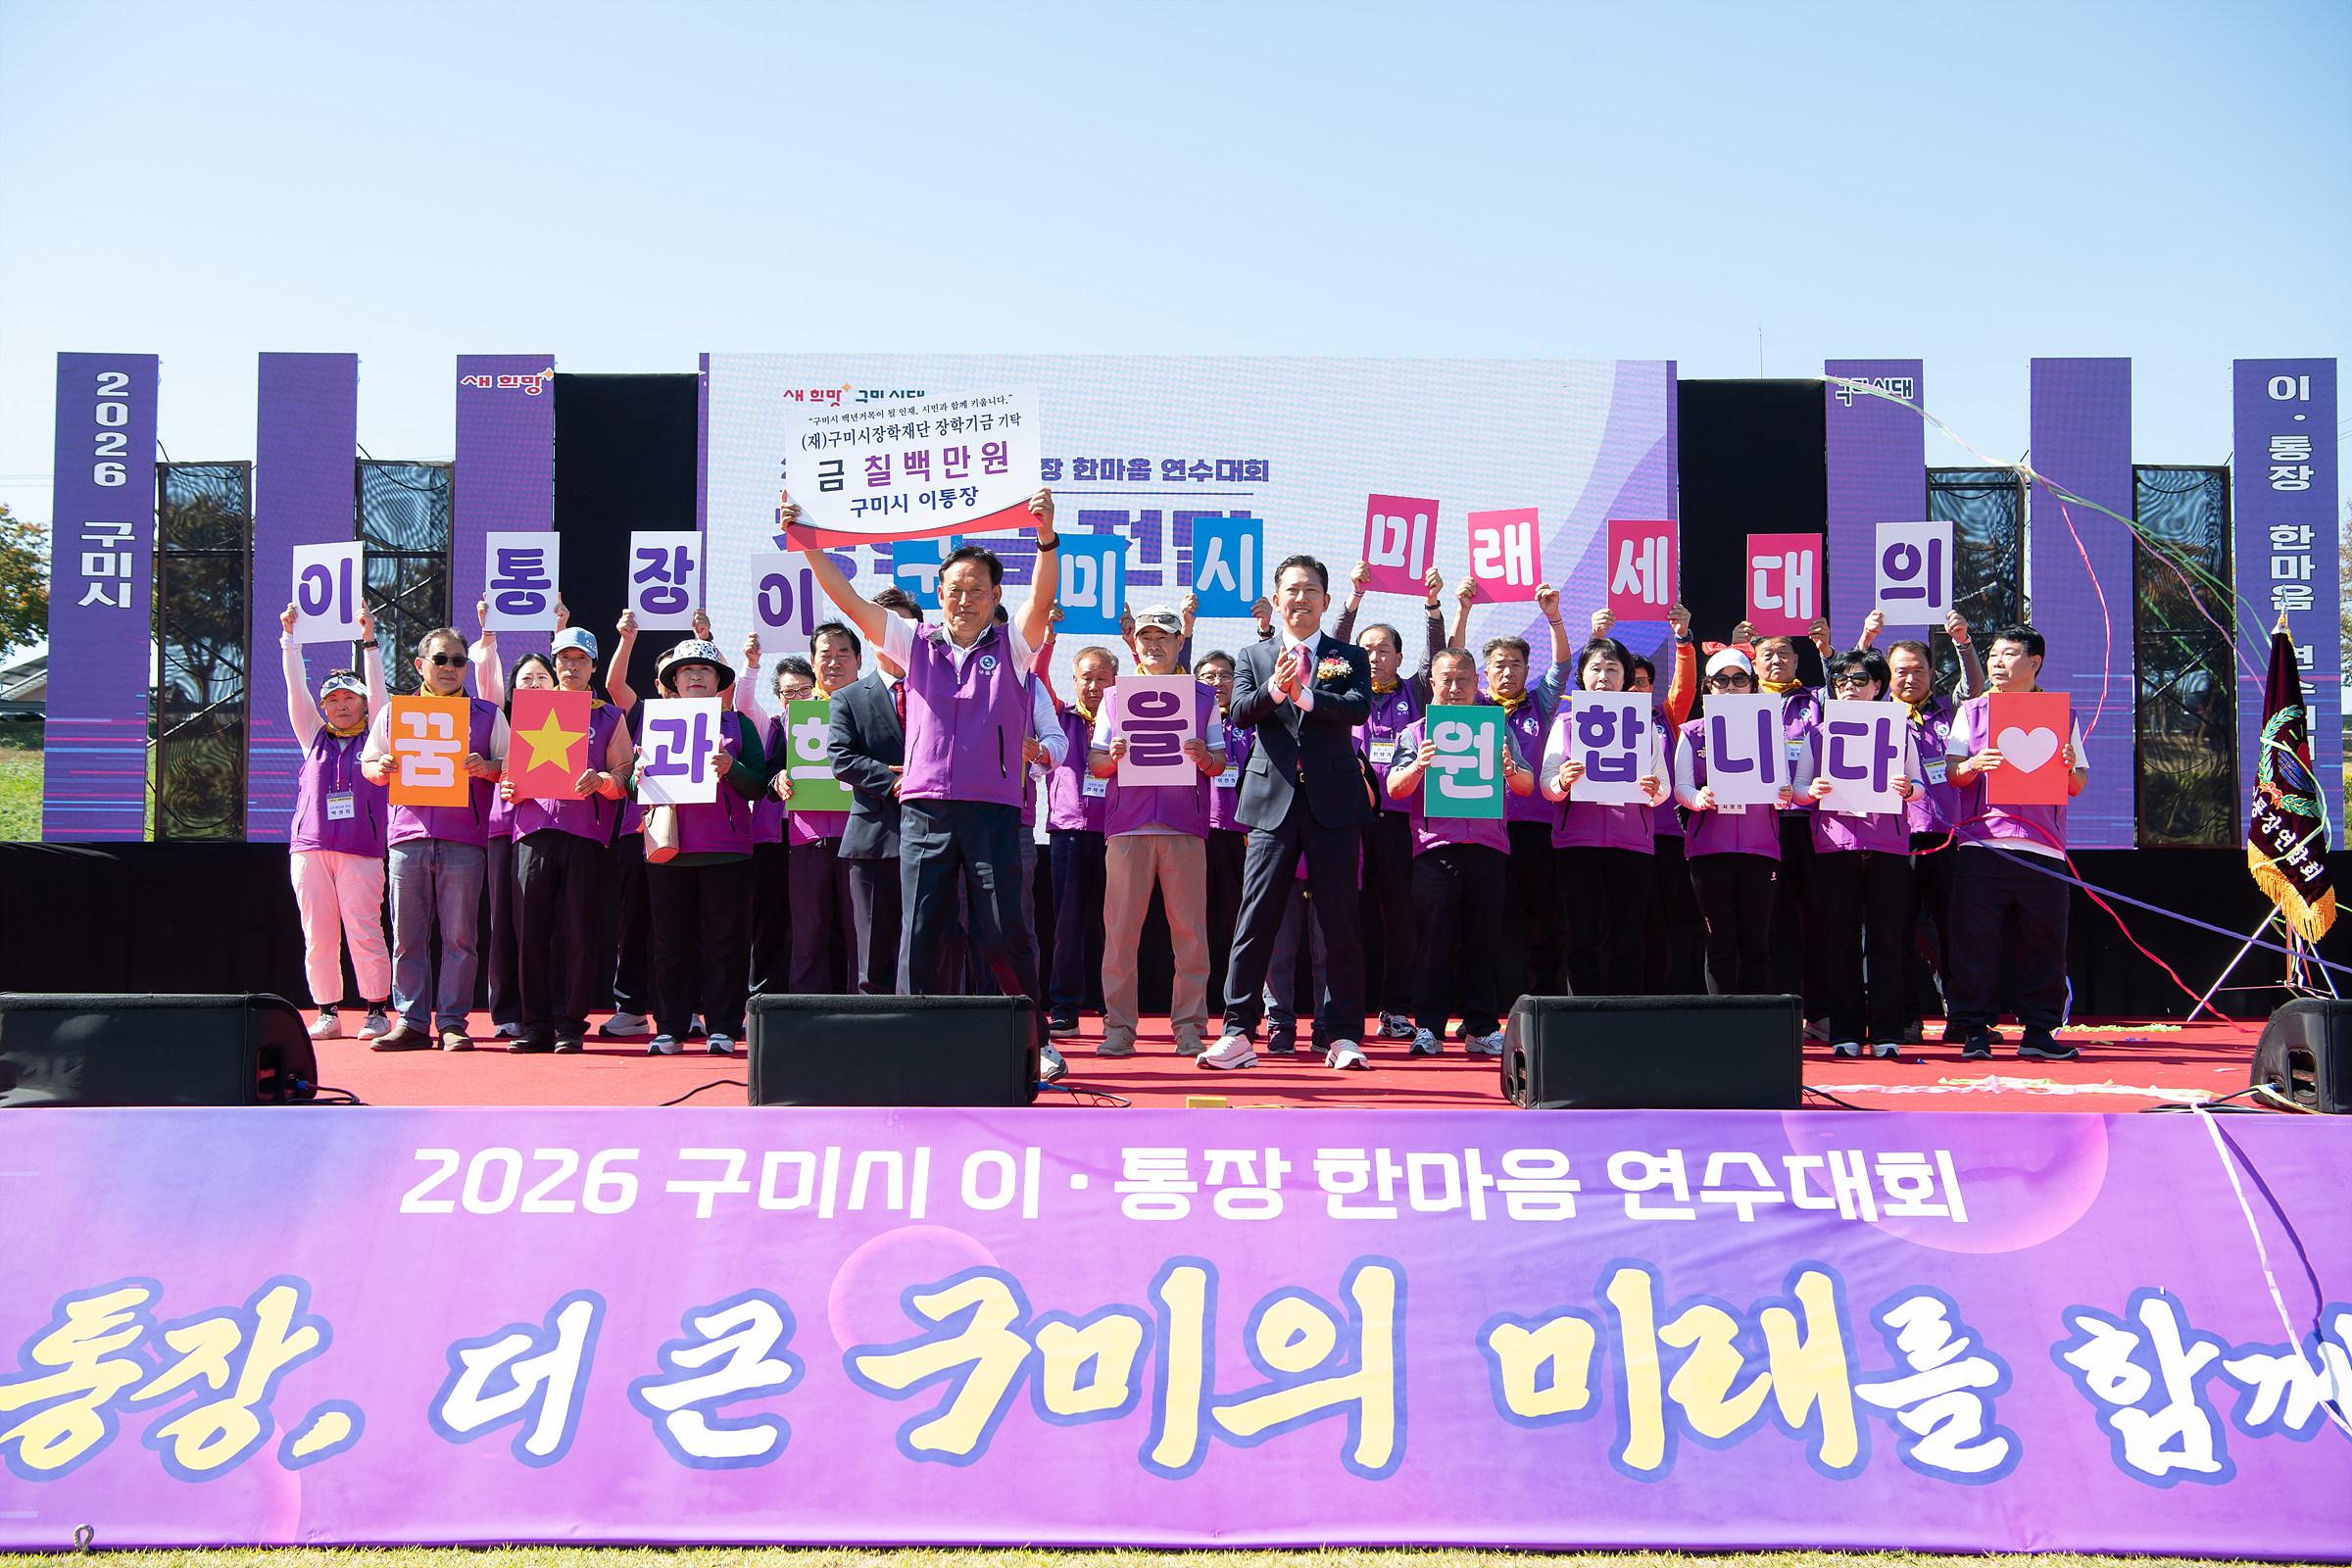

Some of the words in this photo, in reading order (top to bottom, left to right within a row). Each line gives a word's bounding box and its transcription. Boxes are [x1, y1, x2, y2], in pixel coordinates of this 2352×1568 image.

[462, 375, 492, 388] 새
[498, 375, 544, 396] 희망
[783, 389, 804, 402] 새
[809, 389, 842, 407] 희망
[842, 410, 884, 422] 백년거목이
[887, 408, 896, 418] 될
[922, 402, 948, 414] 시민과
[951, 400, 968, 411] 함께
[93, 371, 129, 487] 2026
[802, 419, 930, 452] (재)구미시장학재단
[935, 414, 994, 436] 장학기금
[998, 412, 1022, 428] 기탁
[817, 459, 845, 492] 금
[850, 493, 908, 517] 구미시
[918, 485, 979, 510] 이통장
[1072, 458, 1152, 481] 한마음
[1160, 459, 1269, 482] 연수대회
[77, 521, 135, 609] 구미시
[490, 548, 552, 614] 통
[633, 546, 694, 614] 장
[1197, 534, 1253, 603] 시
[1368, 514, 1428, 580] 미
[1473, 522, 1533, 586] 래
[1611, 536, 1669, 605] 세
[1881, 538, 1942, 608] 의
[2269, 525, 2316, 611] 한마음
[298, 558, 353, 624] 이
[758, 568, 812, 636] 이
[1060, 551, 1117, 619] 미
[1752, 550, 1813, 620] 대
[394, 711, 461, 787] 꿈
[644, 712, 712, 784] 과
[1122, 691, 1189, 765] 을
[1433, 721, 1494, 798] 원
[1576, 706, 1644, 782] 합
[1712, 710, 1775, 783] 니
[1829, 717, 1898, 793] 다
[400, 1148, 639, 1214] 2026
[665, 1147, 930, 1219] 구미시
[1313, 1148, 1581, 1221] 한마음
[1607, 1149, 1967, 1223] 연수대회
[442, 1300, 594, 1455] 더
[641, 1300, 791, 1457] 큰
[857, 1266, 1395, 1469] 구미의
[1489, 1267, 2010, 1475] 미래를
